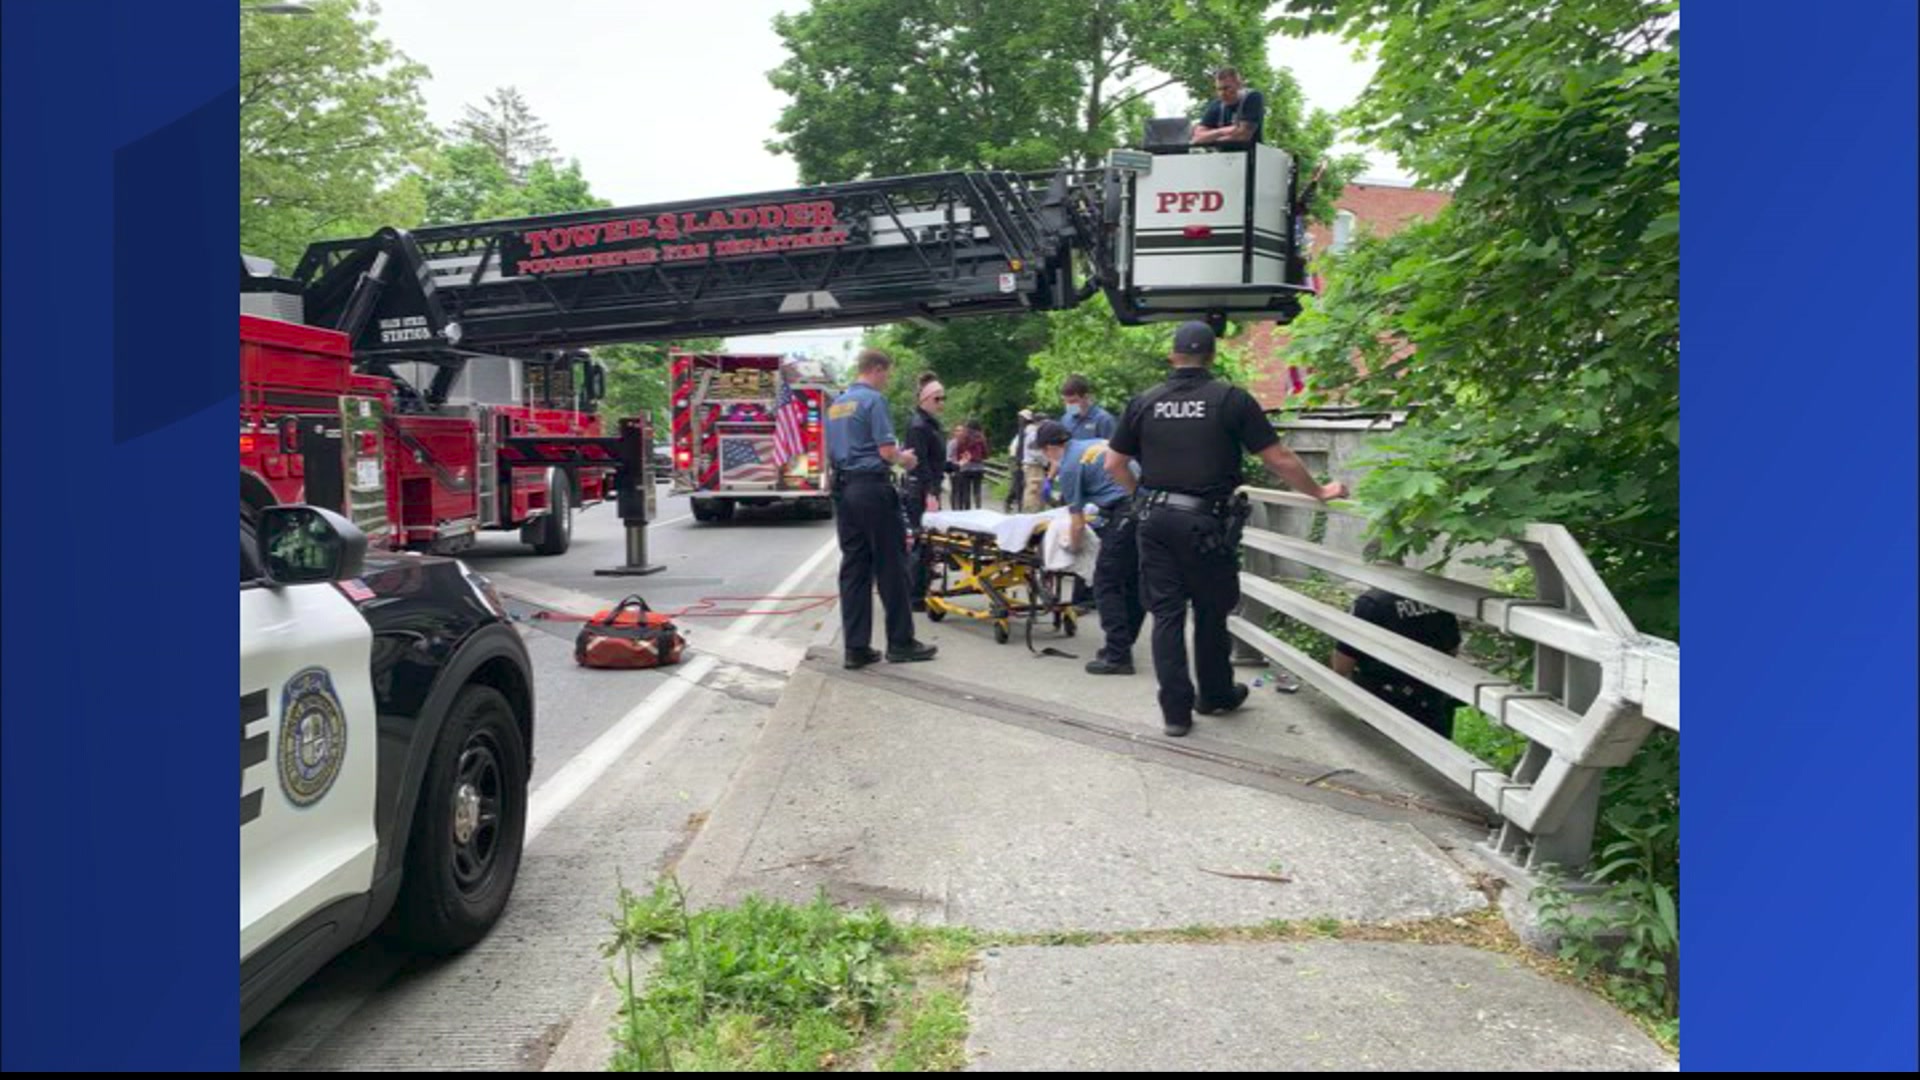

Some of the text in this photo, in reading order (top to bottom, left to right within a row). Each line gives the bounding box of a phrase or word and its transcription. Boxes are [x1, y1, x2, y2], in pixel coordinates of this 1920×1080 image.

[1156, 190, 1224, 213] PFD
[525, 219, 650, 257] TOWER
[682, 201, 835, 233] LADDER
[1154, 401, 1206, 418] POLICE
